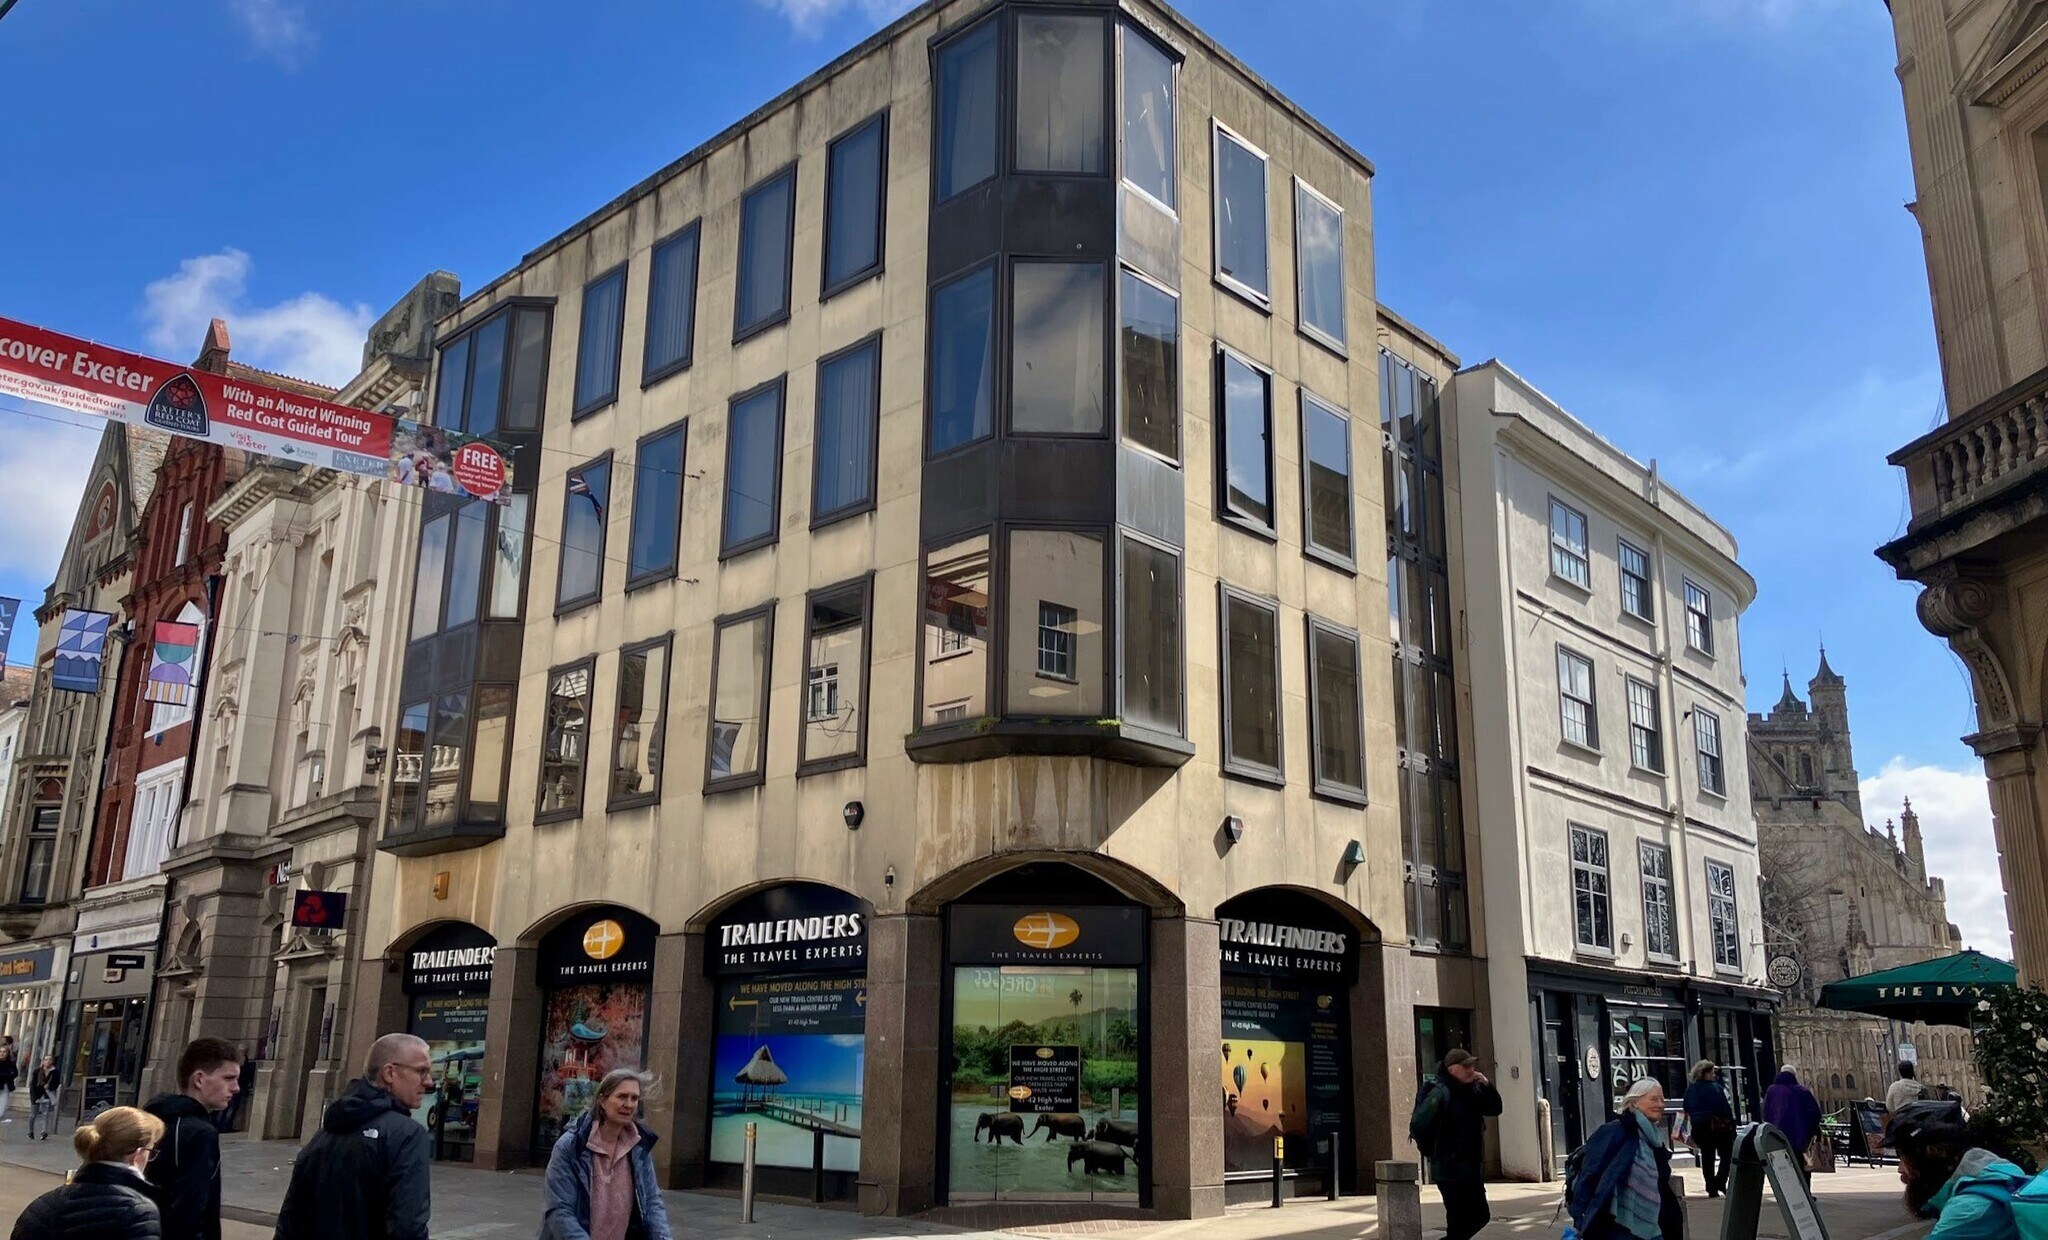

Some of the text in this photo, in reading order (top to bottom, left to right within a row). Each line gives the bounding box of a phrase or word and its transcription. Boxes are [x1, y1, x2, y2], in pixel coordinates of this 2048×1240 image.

[72, 351, 154, 393] Exeter
[20, 387, 59, 404] Christmas
[155, 403, 201, 421] EXETER'S
[222, 384, 372, 434] With an Award Winning
[155, 411, 200, 427] RED COAT
[227, 404, 363, 446] Red Coat Guided Tour
[230, 431, 252, 443] visit
[336, 453, 384, 469] EXETER
[463, 448, 498, 471] FREE
[720, 913, 862, 947] TRAILFINDERS
[1219, 918, 1346, 954] TRAILFINDERS
[412, 946, 497, 970] TRAILFINDERS
[724, 945, 863, 964] THE TRAVEL EXPERTS
[1059, 952, 1103, 960] EXPERTS
[1219, 949, 1342, 972] THE TRAVEL EXPERTS
[560, 961, 648, 975] THE TRAVEL EXPERTS
[414, 975, 428, 984] THE
[432, 973, 460, 983] TRAVEL
[740, 978, 867, 994] WE HAVE MOVED ALONG THE HIGH STR
[769, 997, 779, 1005] OUR
[780, 996, 790, 1004] NEW
[790, 996, 805, 1004] TRAVEL
[829, 994, 843, 1002] OPEN
[1877, 986, 1985, 998] THE IVY
[1037, 1096, 1052, 1105] High
[1053, 1096, 1072, 1104] Street
